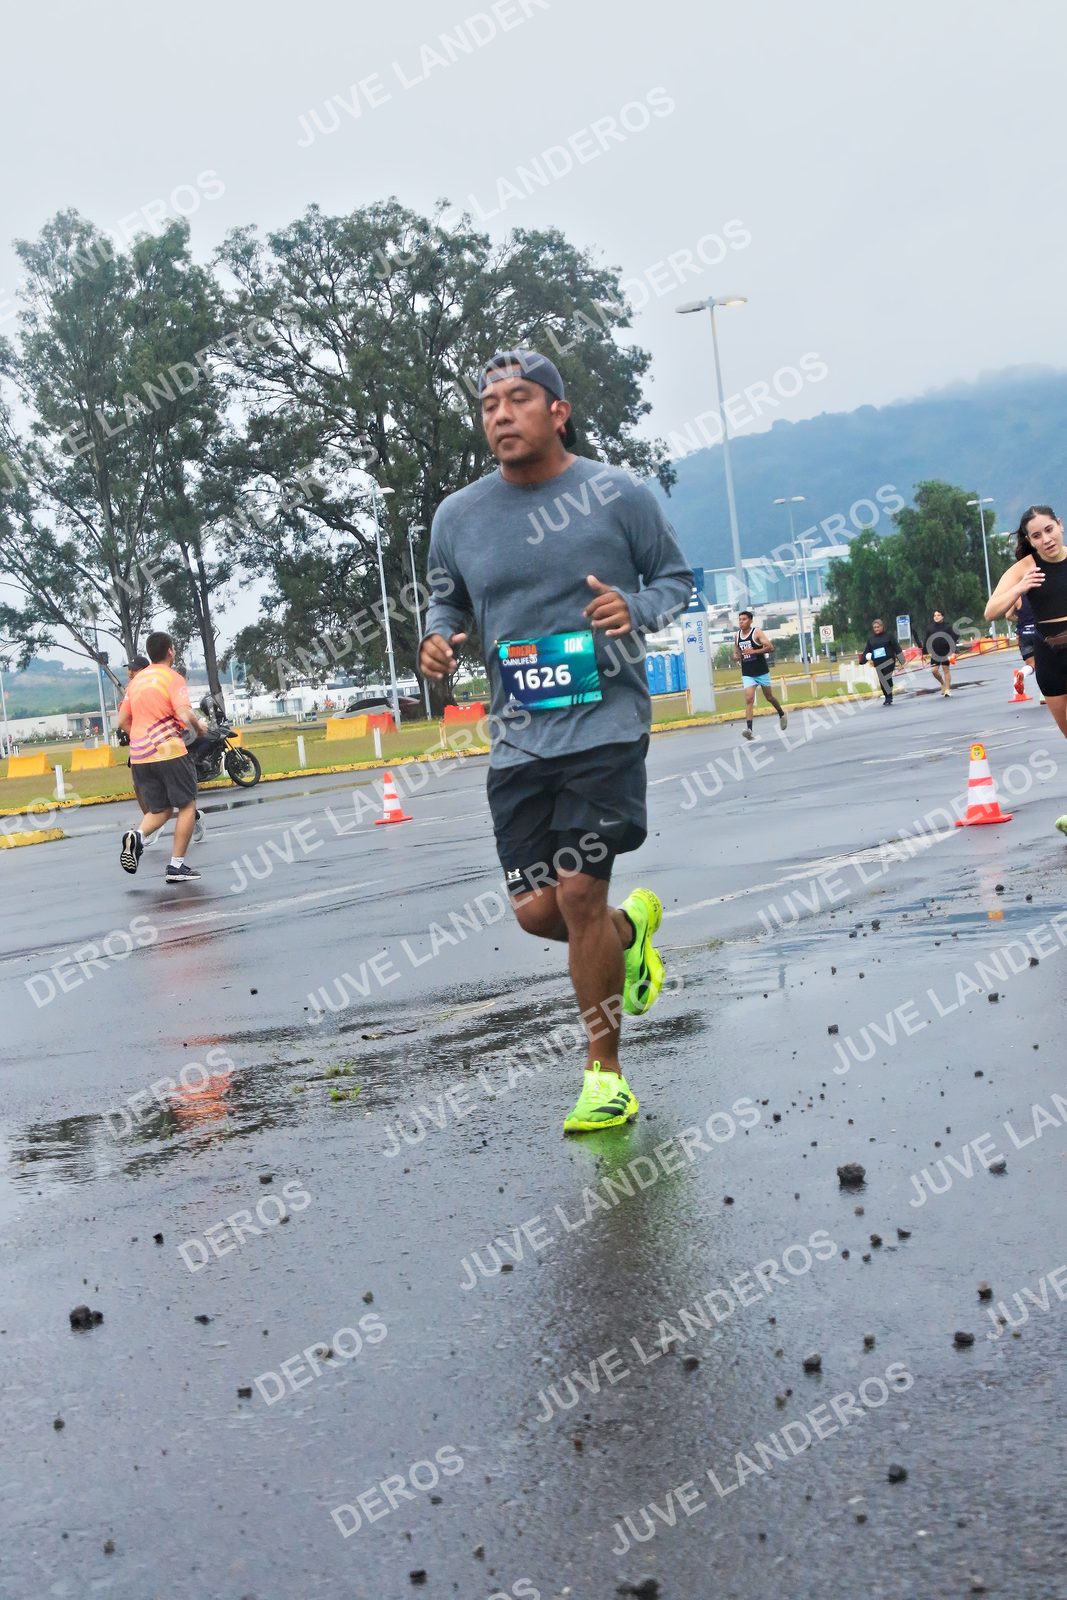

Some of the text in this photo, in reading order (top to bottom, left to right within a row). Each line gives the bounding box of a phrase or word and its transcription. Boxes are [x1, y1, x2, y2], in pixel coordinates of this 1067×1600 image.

[564, 637, 584, 653] 10K
[696, 620, 705, 653] General
[502, 657, 530, 667] OMNILIFE
[514, 664, 571, 690] 1626
